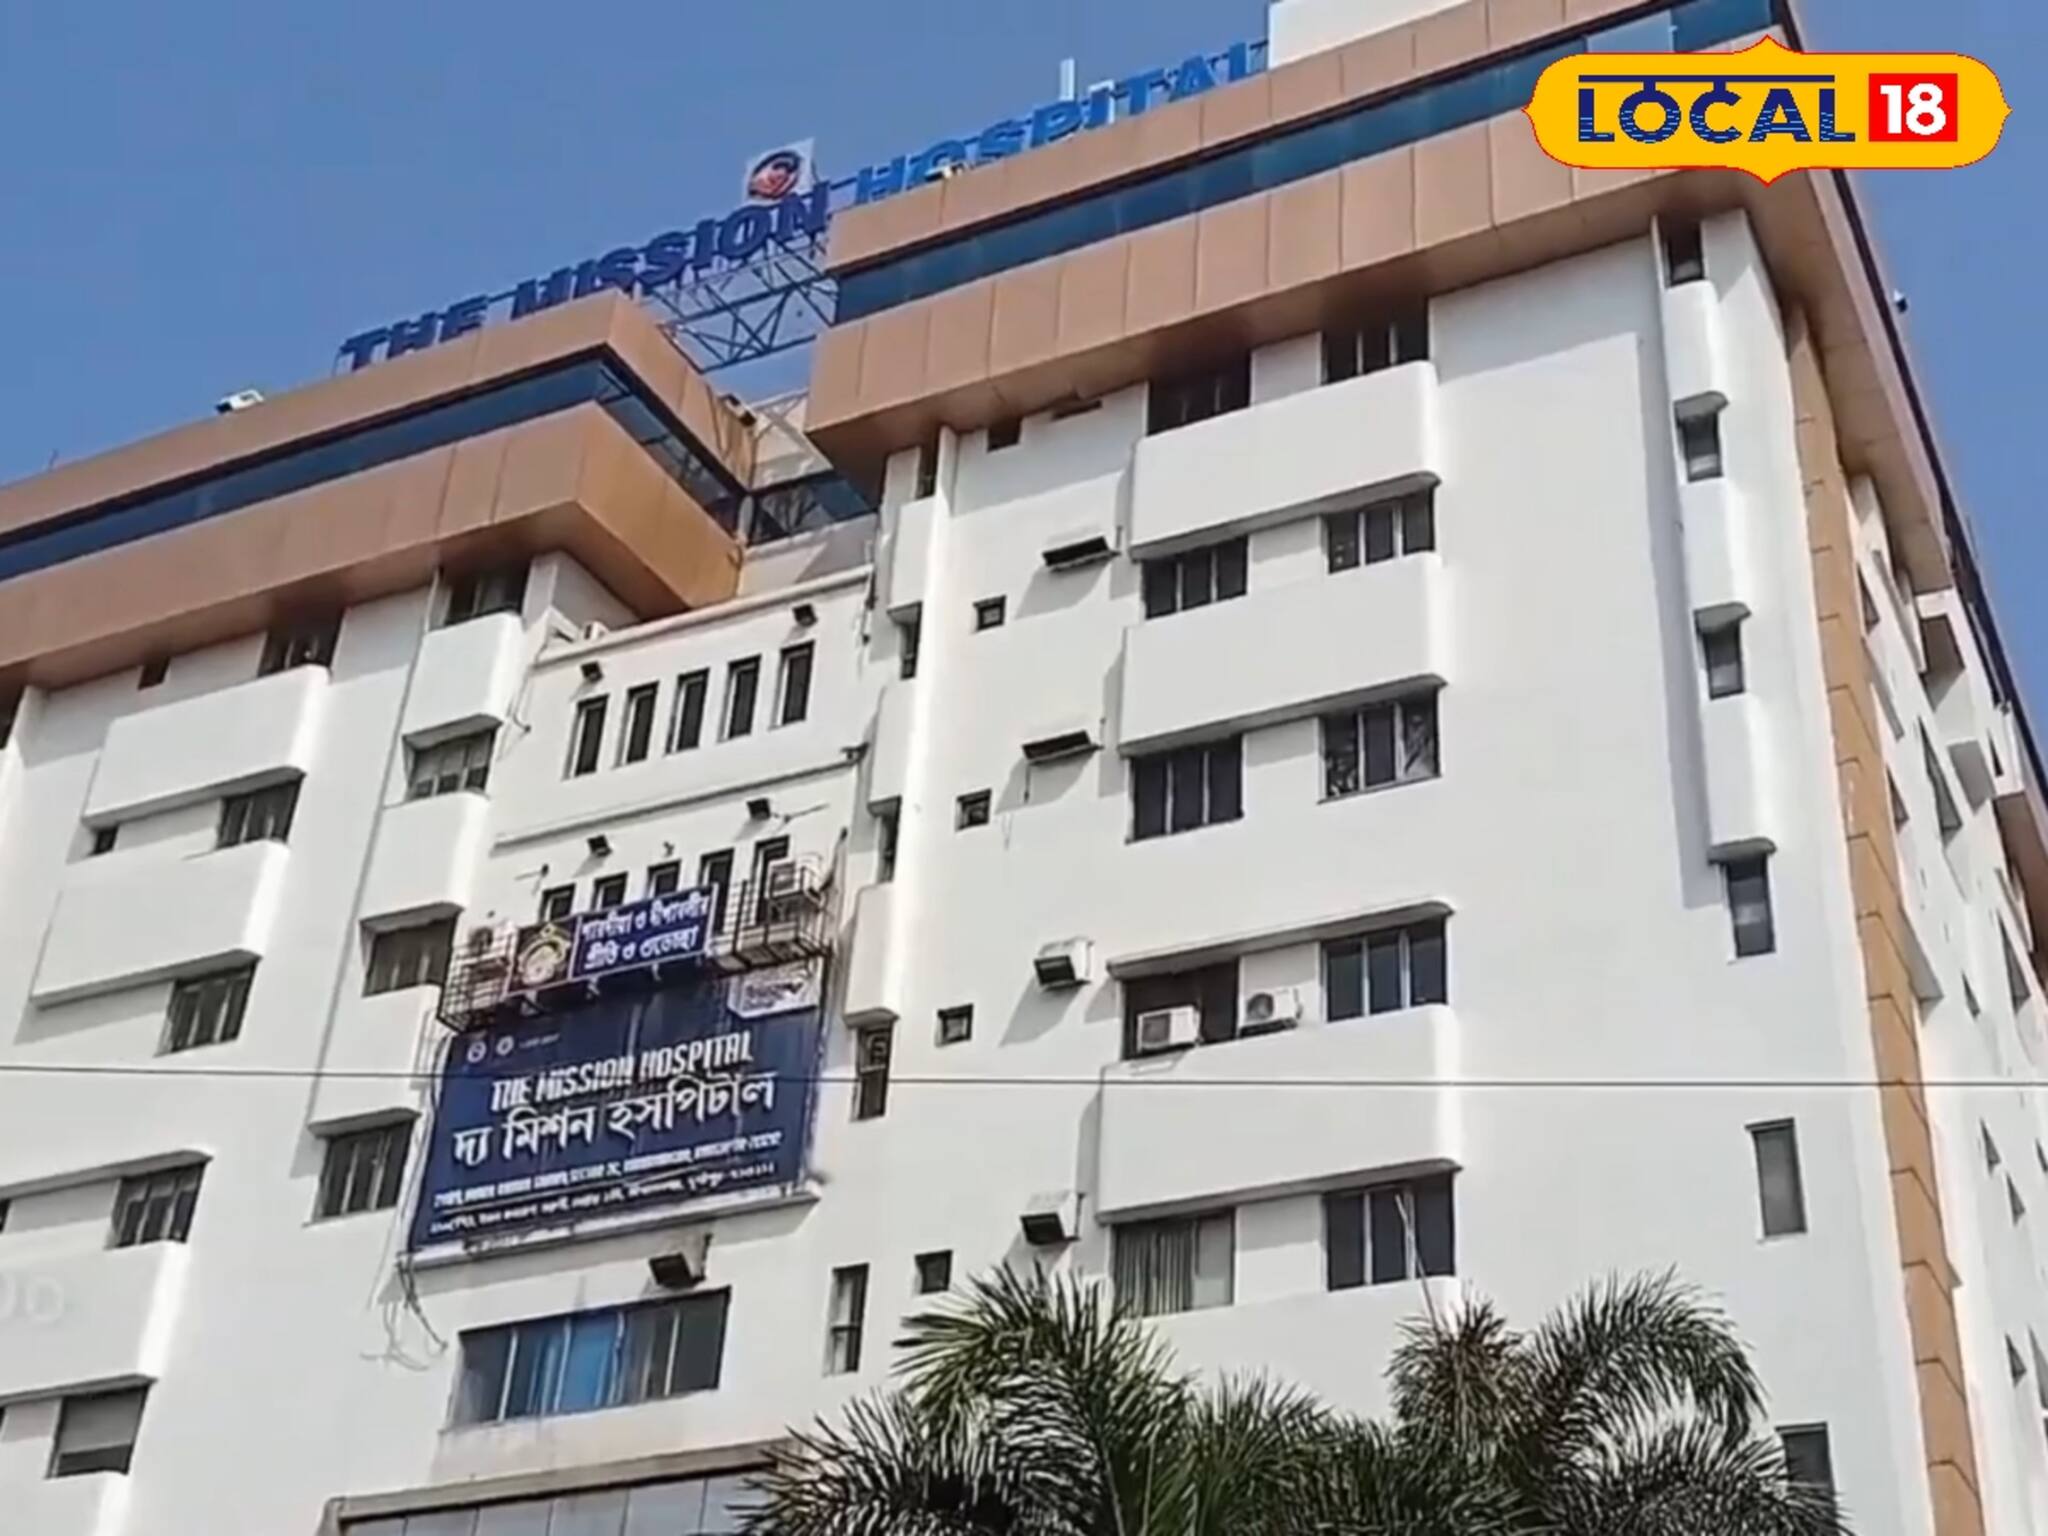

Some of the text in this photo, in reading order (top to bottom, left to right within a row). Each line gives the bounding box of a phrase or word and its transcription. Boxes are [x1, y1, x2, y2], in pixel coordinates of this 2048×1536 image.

[340, 294, 489, 372] THE
[510, 180, 831, 320] MISSION
[490, 1030, 754, 1112] THE MISSION HOSPITAL
[501, 1105, 597, 1160] মিশন
[606, 1071, 778, 1140] হসপিটাল
